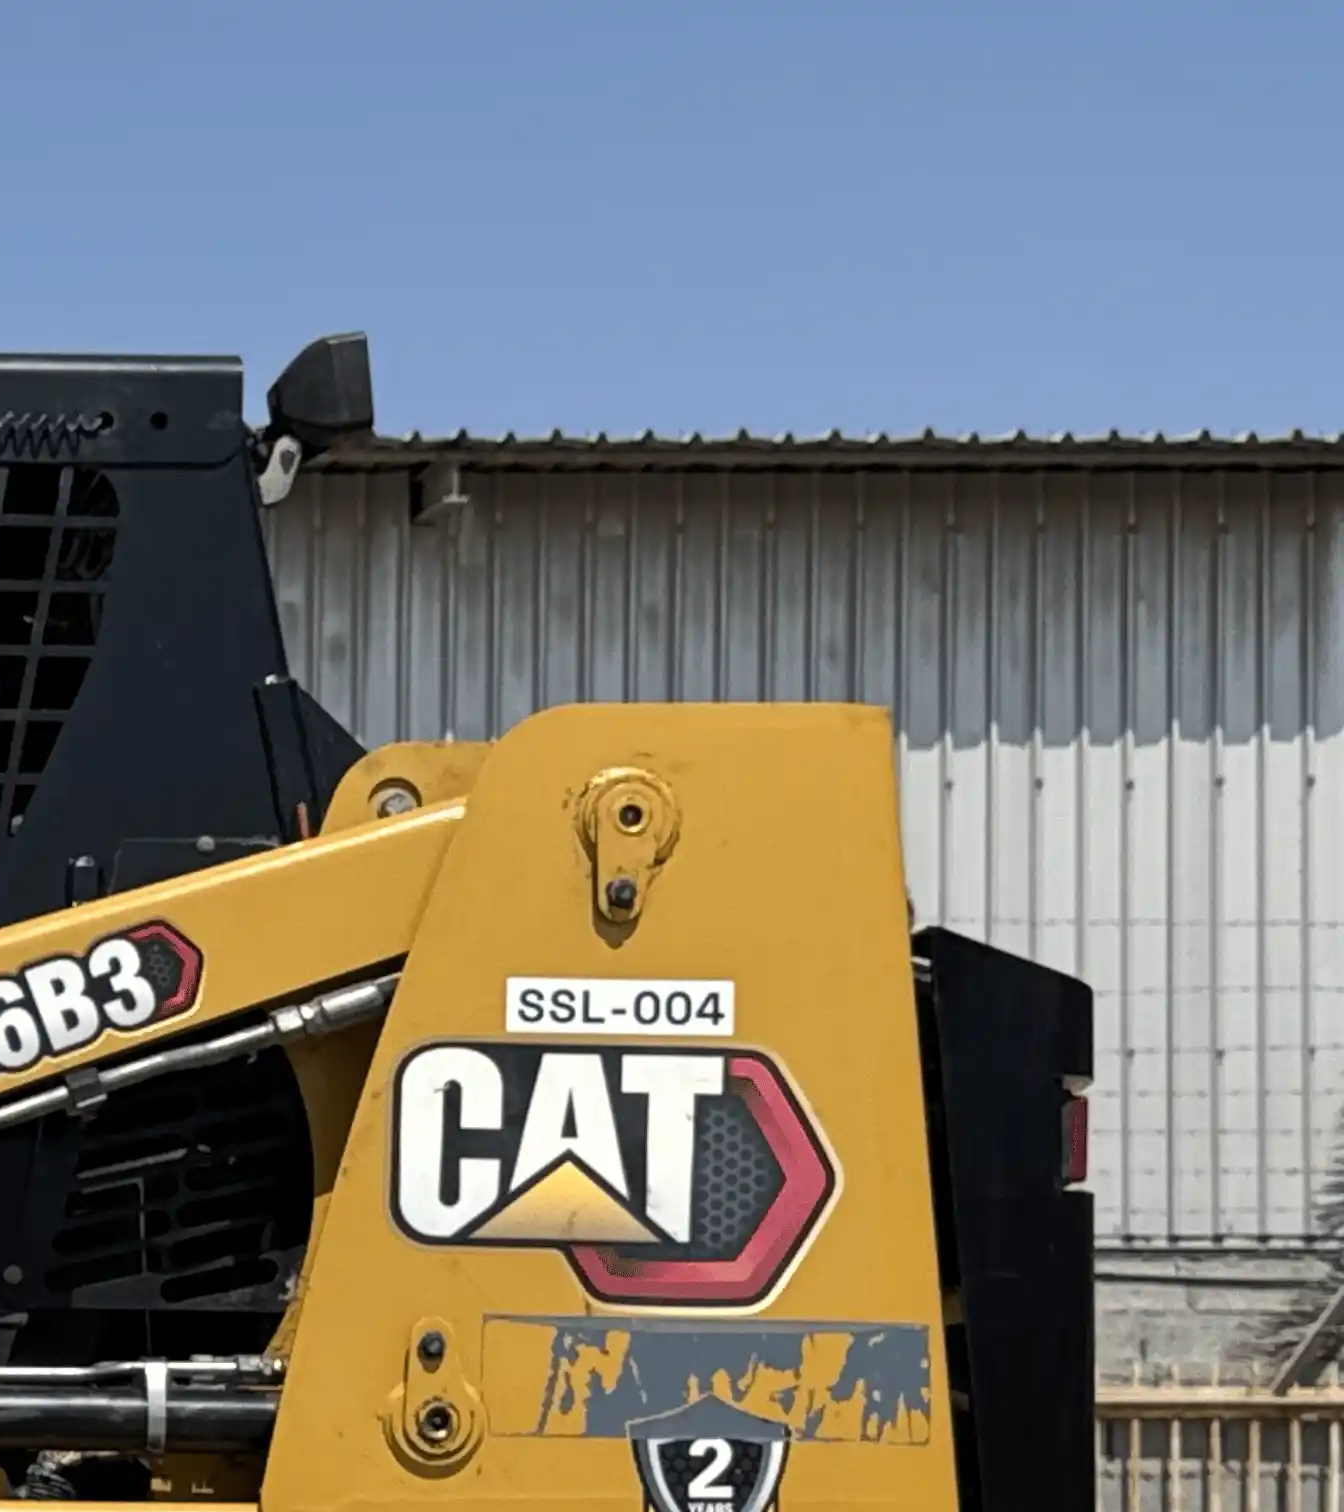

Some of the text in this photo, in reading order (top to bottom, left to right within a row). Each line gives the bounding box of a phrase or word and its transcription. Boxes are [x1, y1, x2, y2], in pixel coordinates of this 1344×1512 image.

[517, 989, 726, 1026] SSL-004
[400, 1046, 725, 1243] CAT
[688, 1438, 734, 1499] 2
